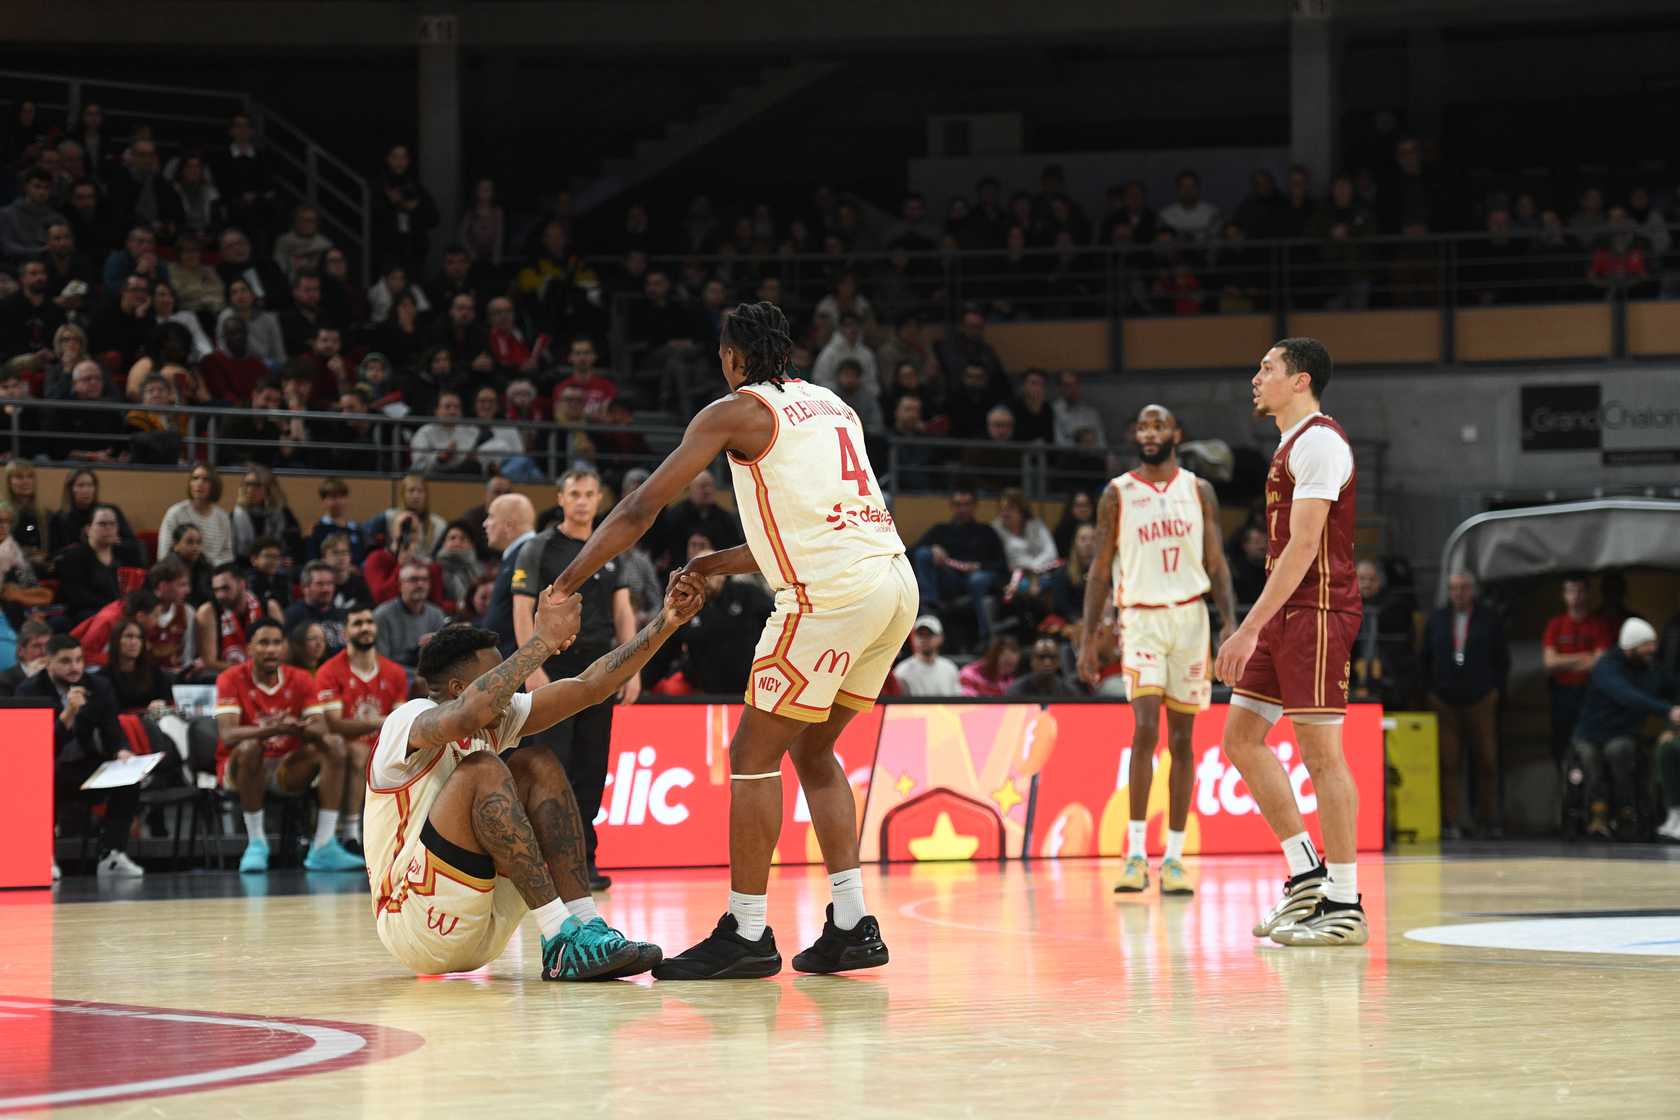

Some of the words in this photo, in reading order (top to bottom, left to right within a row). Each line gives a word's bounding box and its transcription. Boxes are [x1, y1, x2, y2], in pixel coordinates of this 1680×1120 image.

[834, 427, 872, 496] 4
[1138, 518, 1192, 545] NANCY
[1162, 547, 1180, 573] 17
[758, 676, 781, 693] NCY
